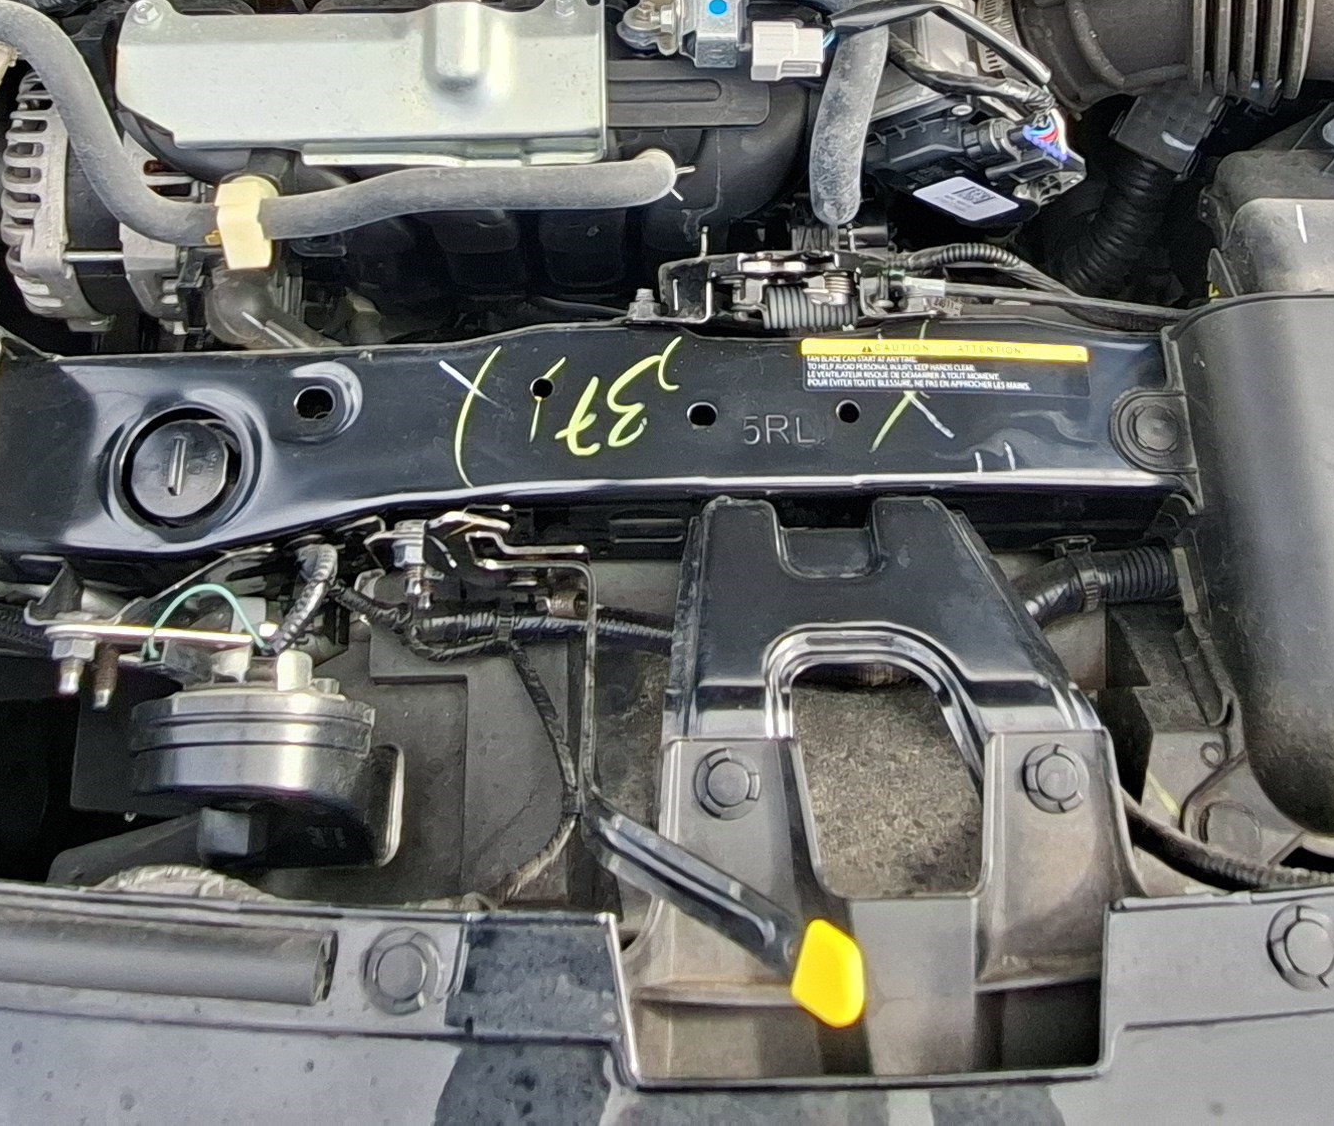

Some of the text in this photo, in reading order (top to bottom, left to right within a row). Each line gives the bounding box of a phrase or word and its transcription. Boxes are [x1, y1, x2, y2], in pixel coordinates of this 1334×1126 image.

[874, 343, 929, 352] CAUTION
[957, 344, 1021, 354] ATTENTION
[821, 355, 841, 363] BLADE
[842, 355, 857, 363] CAN
[858, 355, 876, 363] START
[877, 355, 886, 363] AT
[887, 355, 899, 363] ANY
[856, 363, 889, 371] PERSONAL
[864, 371, 889, 379] RISQUE
[853, 379, 876, 387] TOUTE
[925, 380, 939, 388] PAS
[950, 381, 992, 389] APPROCHER
